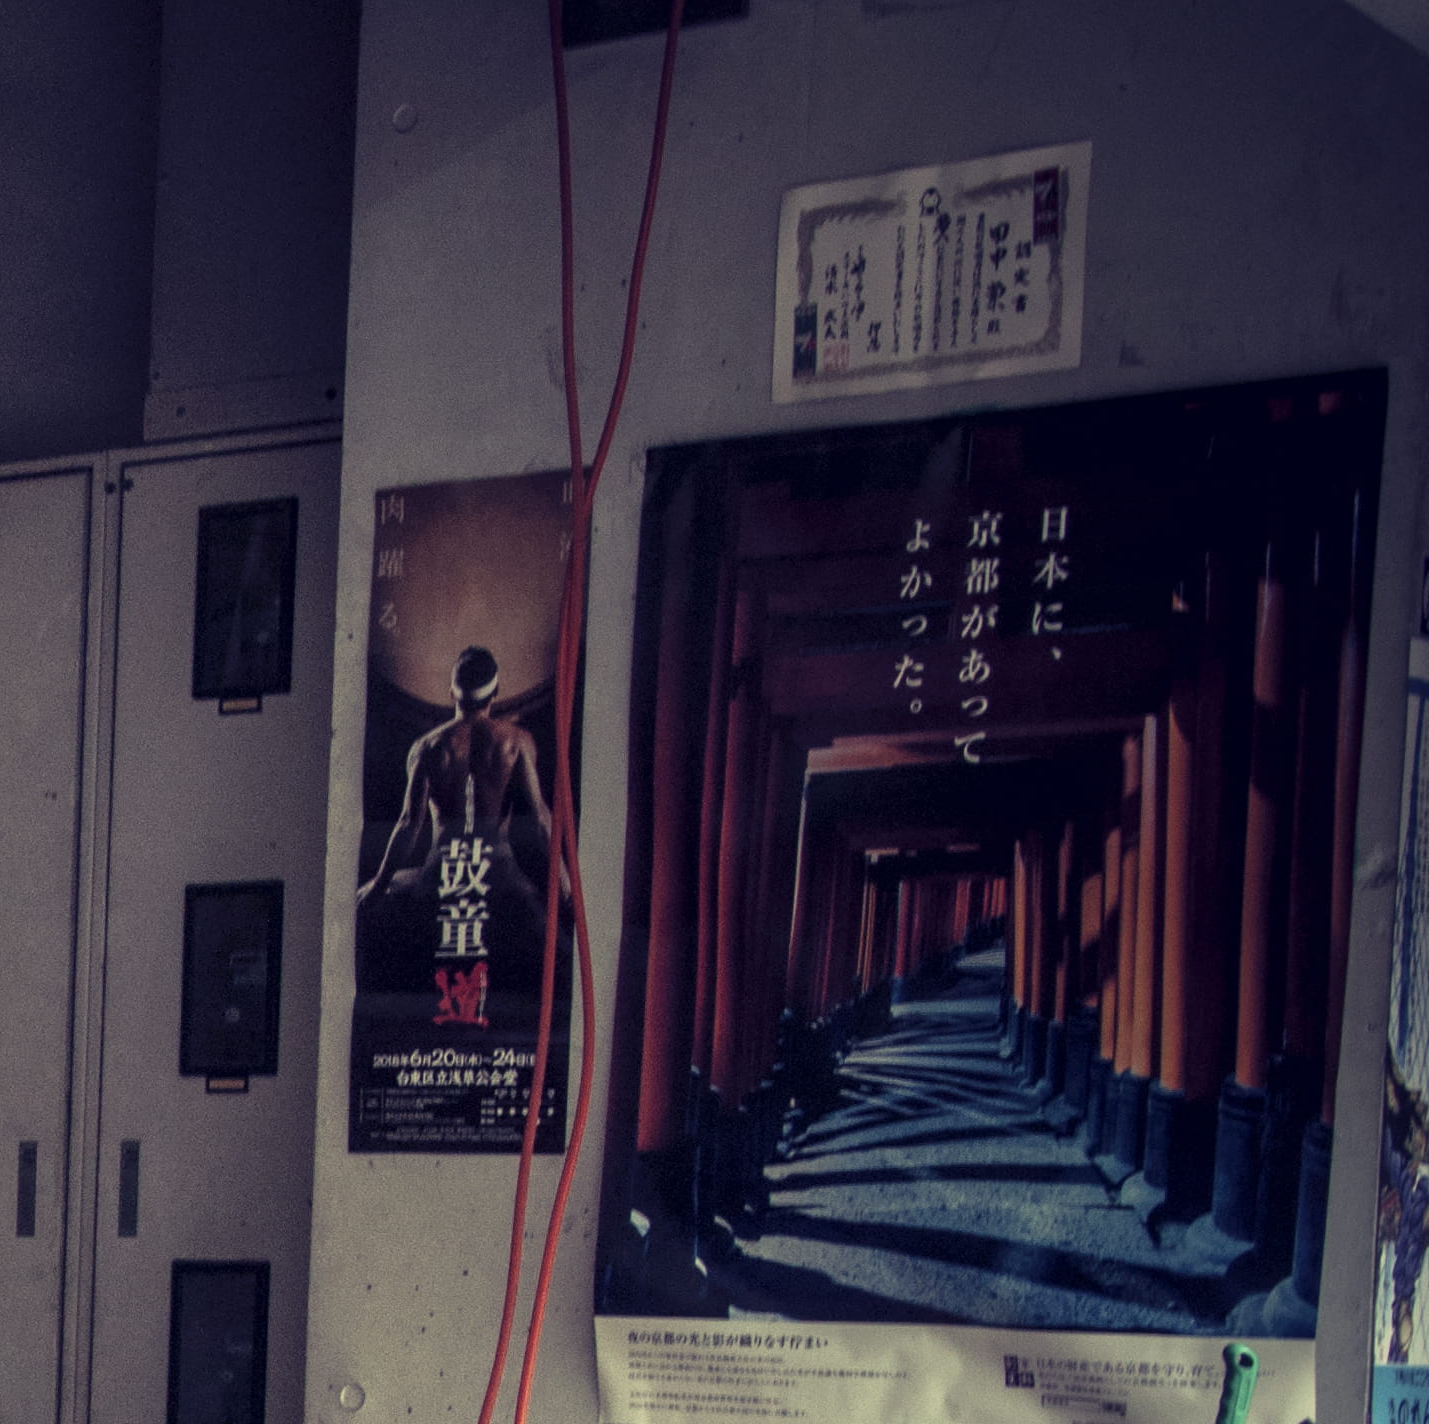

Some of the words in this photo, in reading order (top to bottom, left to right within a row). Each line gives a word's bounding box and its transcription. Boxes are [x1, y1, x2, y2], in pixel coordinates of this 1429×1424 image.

[893, 518, 932, 714] よかった。
[954, 510, 1003, 763] 京都があって
[1031, 506, 1069, 660] 日本に、
